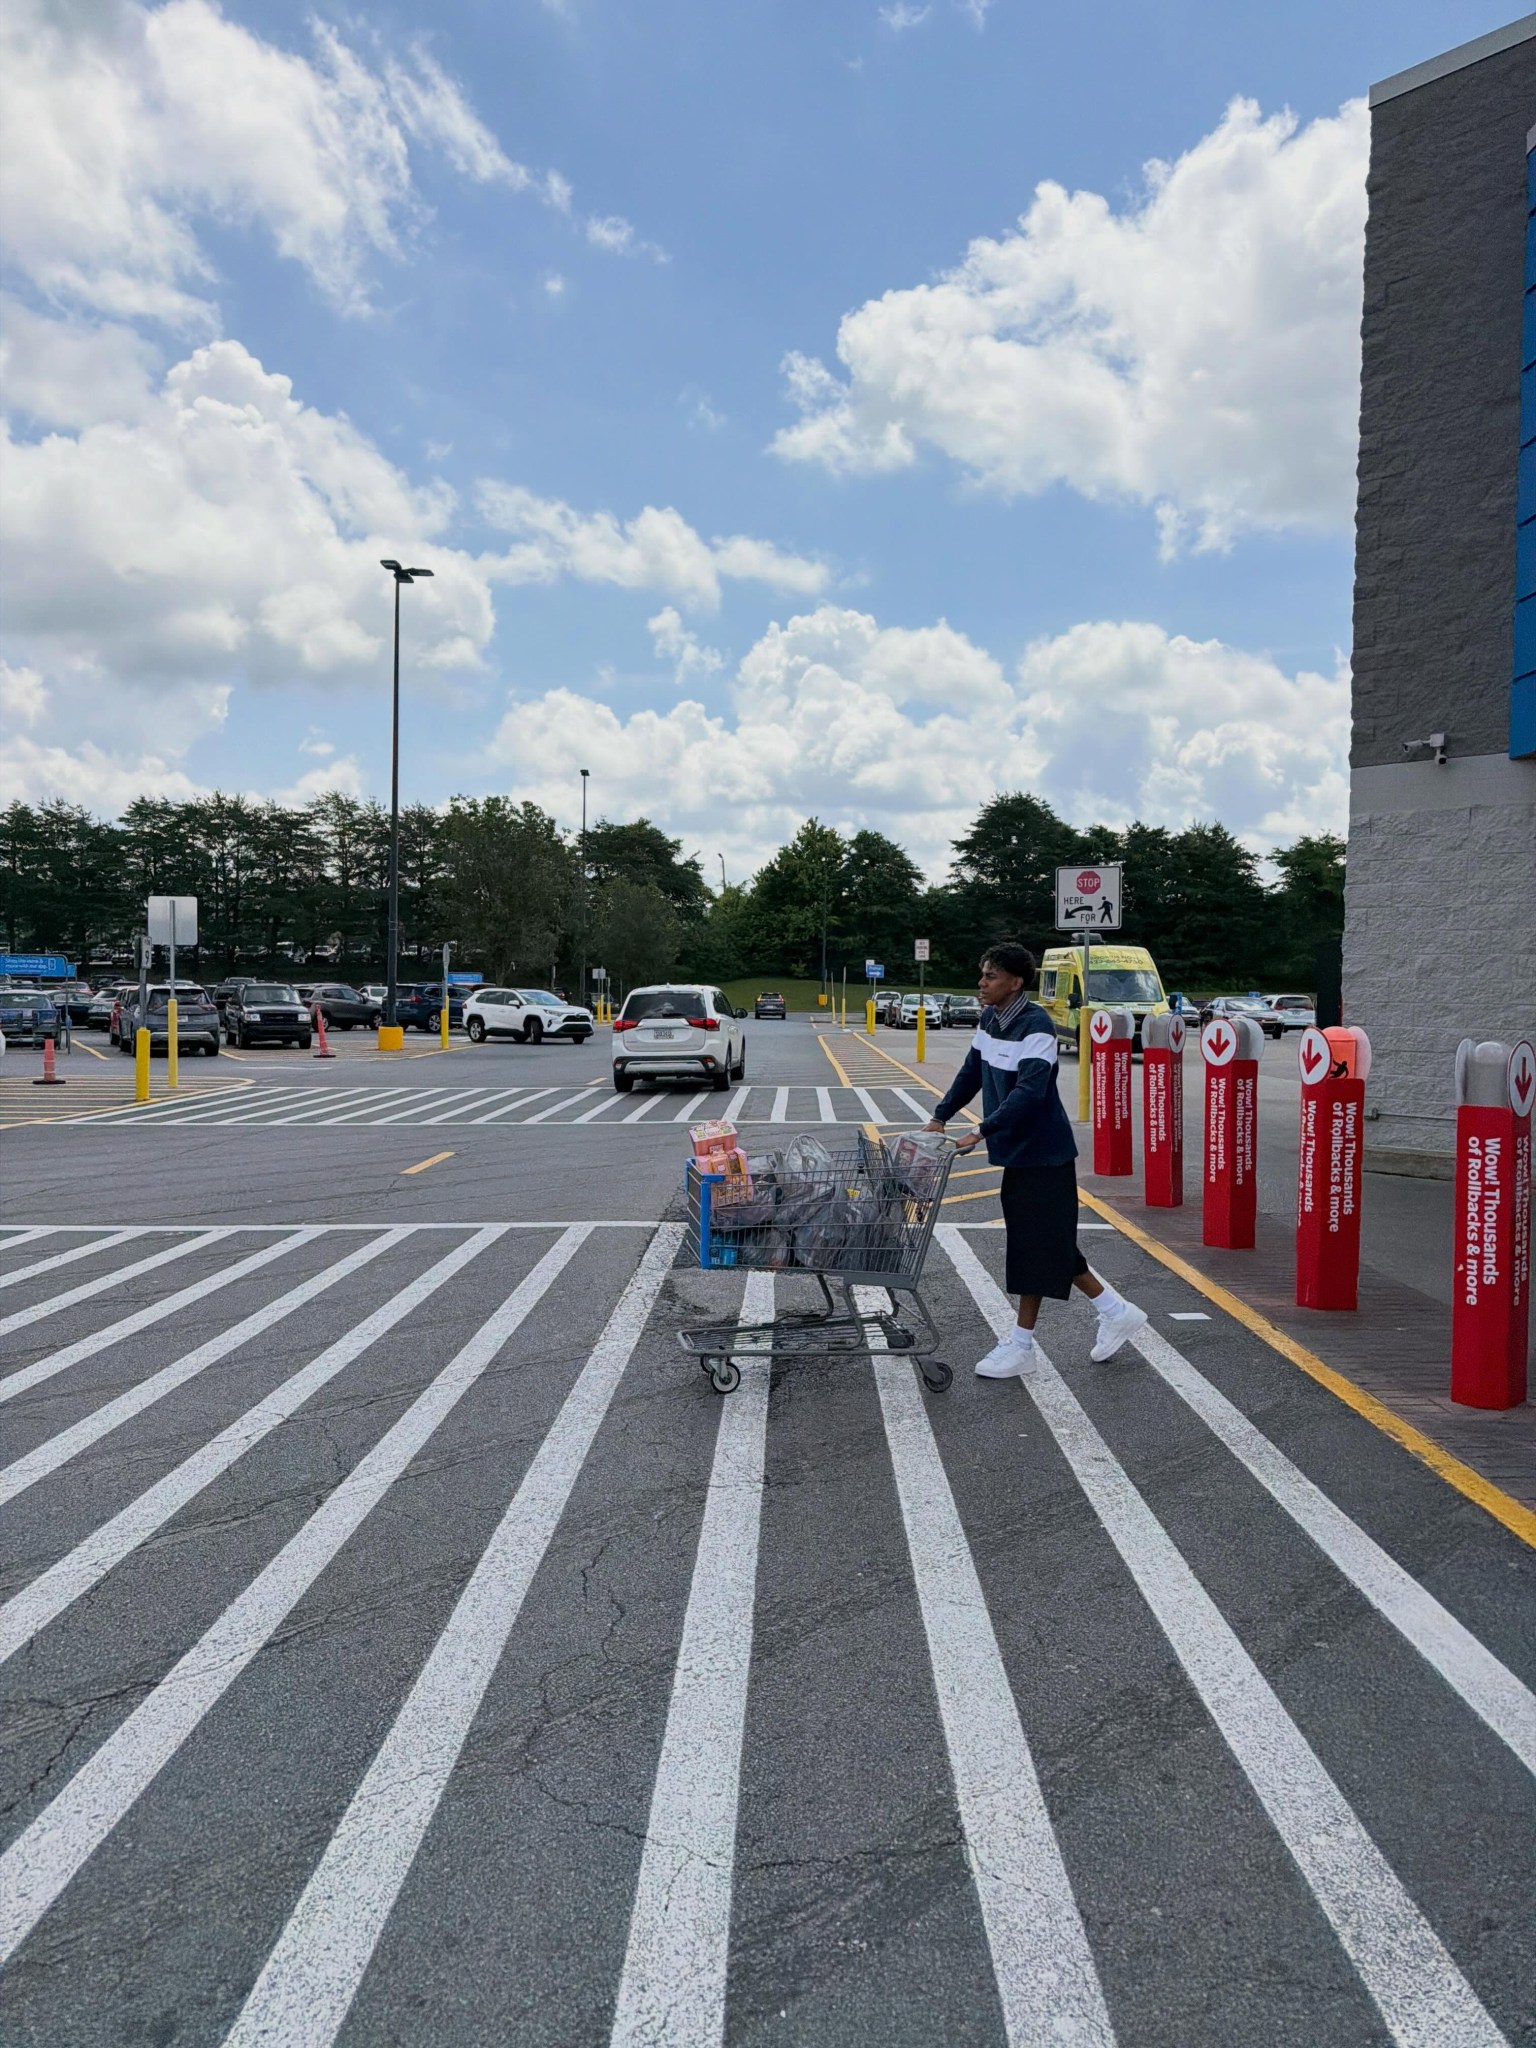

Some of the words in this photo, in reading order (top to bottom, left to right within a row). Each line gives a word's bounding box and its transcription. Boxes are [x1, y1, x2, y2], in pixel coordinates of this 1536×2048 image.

[1064, 896, 1084, 905] HERE
[1078, 878, 1100, 888] STOP
[1080, 914, 1096, 922] FOR
[1096, 1052, 1101, 1061] of
[1114, 1052, 1121, 1061] of
[1149, 1063, 1157, 1074] of
[1149, 1075, 1158, 1119] Rollbacks
[1210, 1077, 1218, 1089] of
[1237, 1079, 1244, 1090] of
[1158, 1090, 1166, 1141] Thousands
[1307, 1100, 1316, 1137] Wow!
[1332, 1101, 1344, 1117] of
[1345, 1102, 1357, 1138] Wow!
[1331, 1118, 1343, 1182] Rollbacks
[1468, 1136, 1482, 1156] of
[1484, 1138, 1500, 1185] Wow!
[1516, 1138, 1523, 1156] of
[1304, 1138, 1315, 1213] Thousands
[1330, 1185, 1341, 1194] &
[1343, 1141, 1356, 1215] Thousands
[1329, 1196, 1340, 1232] more
[1467, 1158, 1481, 1241] Rollbacks
[1515, 1158, 1523, 1242] Rollbacks
[1466, 1243, 1480, 1256] &
[1483, 1188, 1500, 1285] Thousands
[1520, 1186, 1529, 1281] Thousands
[1466, 1259, 1478, 1305] more
